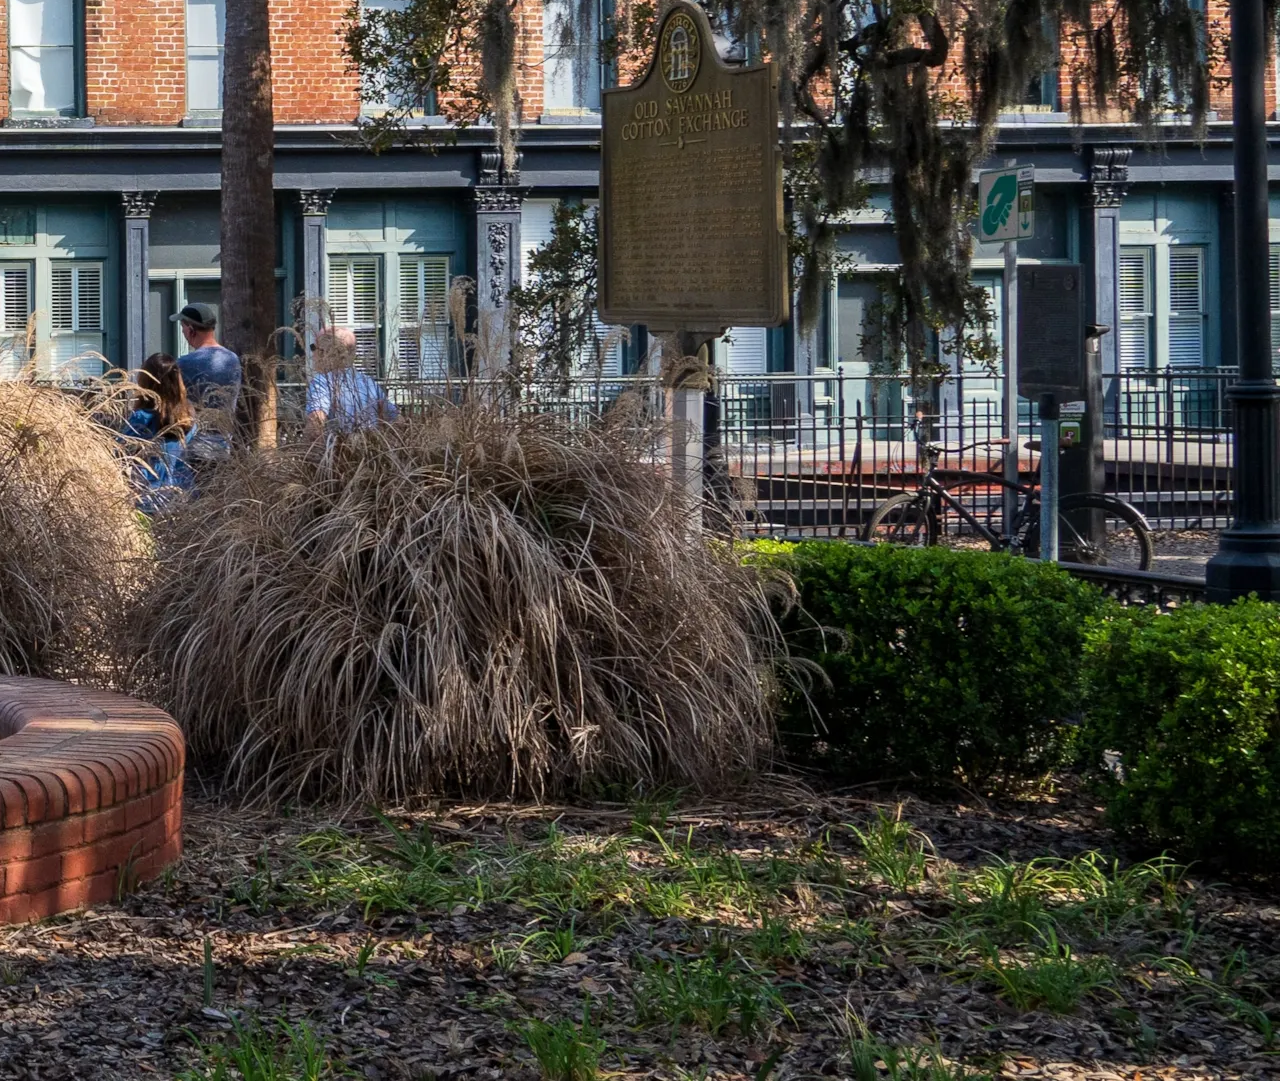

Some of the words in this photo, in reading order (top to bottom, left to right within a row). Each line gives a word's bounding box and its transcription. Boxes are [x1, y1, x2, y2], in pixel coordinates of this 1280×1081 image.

[634, 100, 658, 120] OLD
[665, 89, 733, 115] SAVANNAH
[621, 118, 672, 141] COTTON
[680, 108, 750, 133] EXCHANGE
